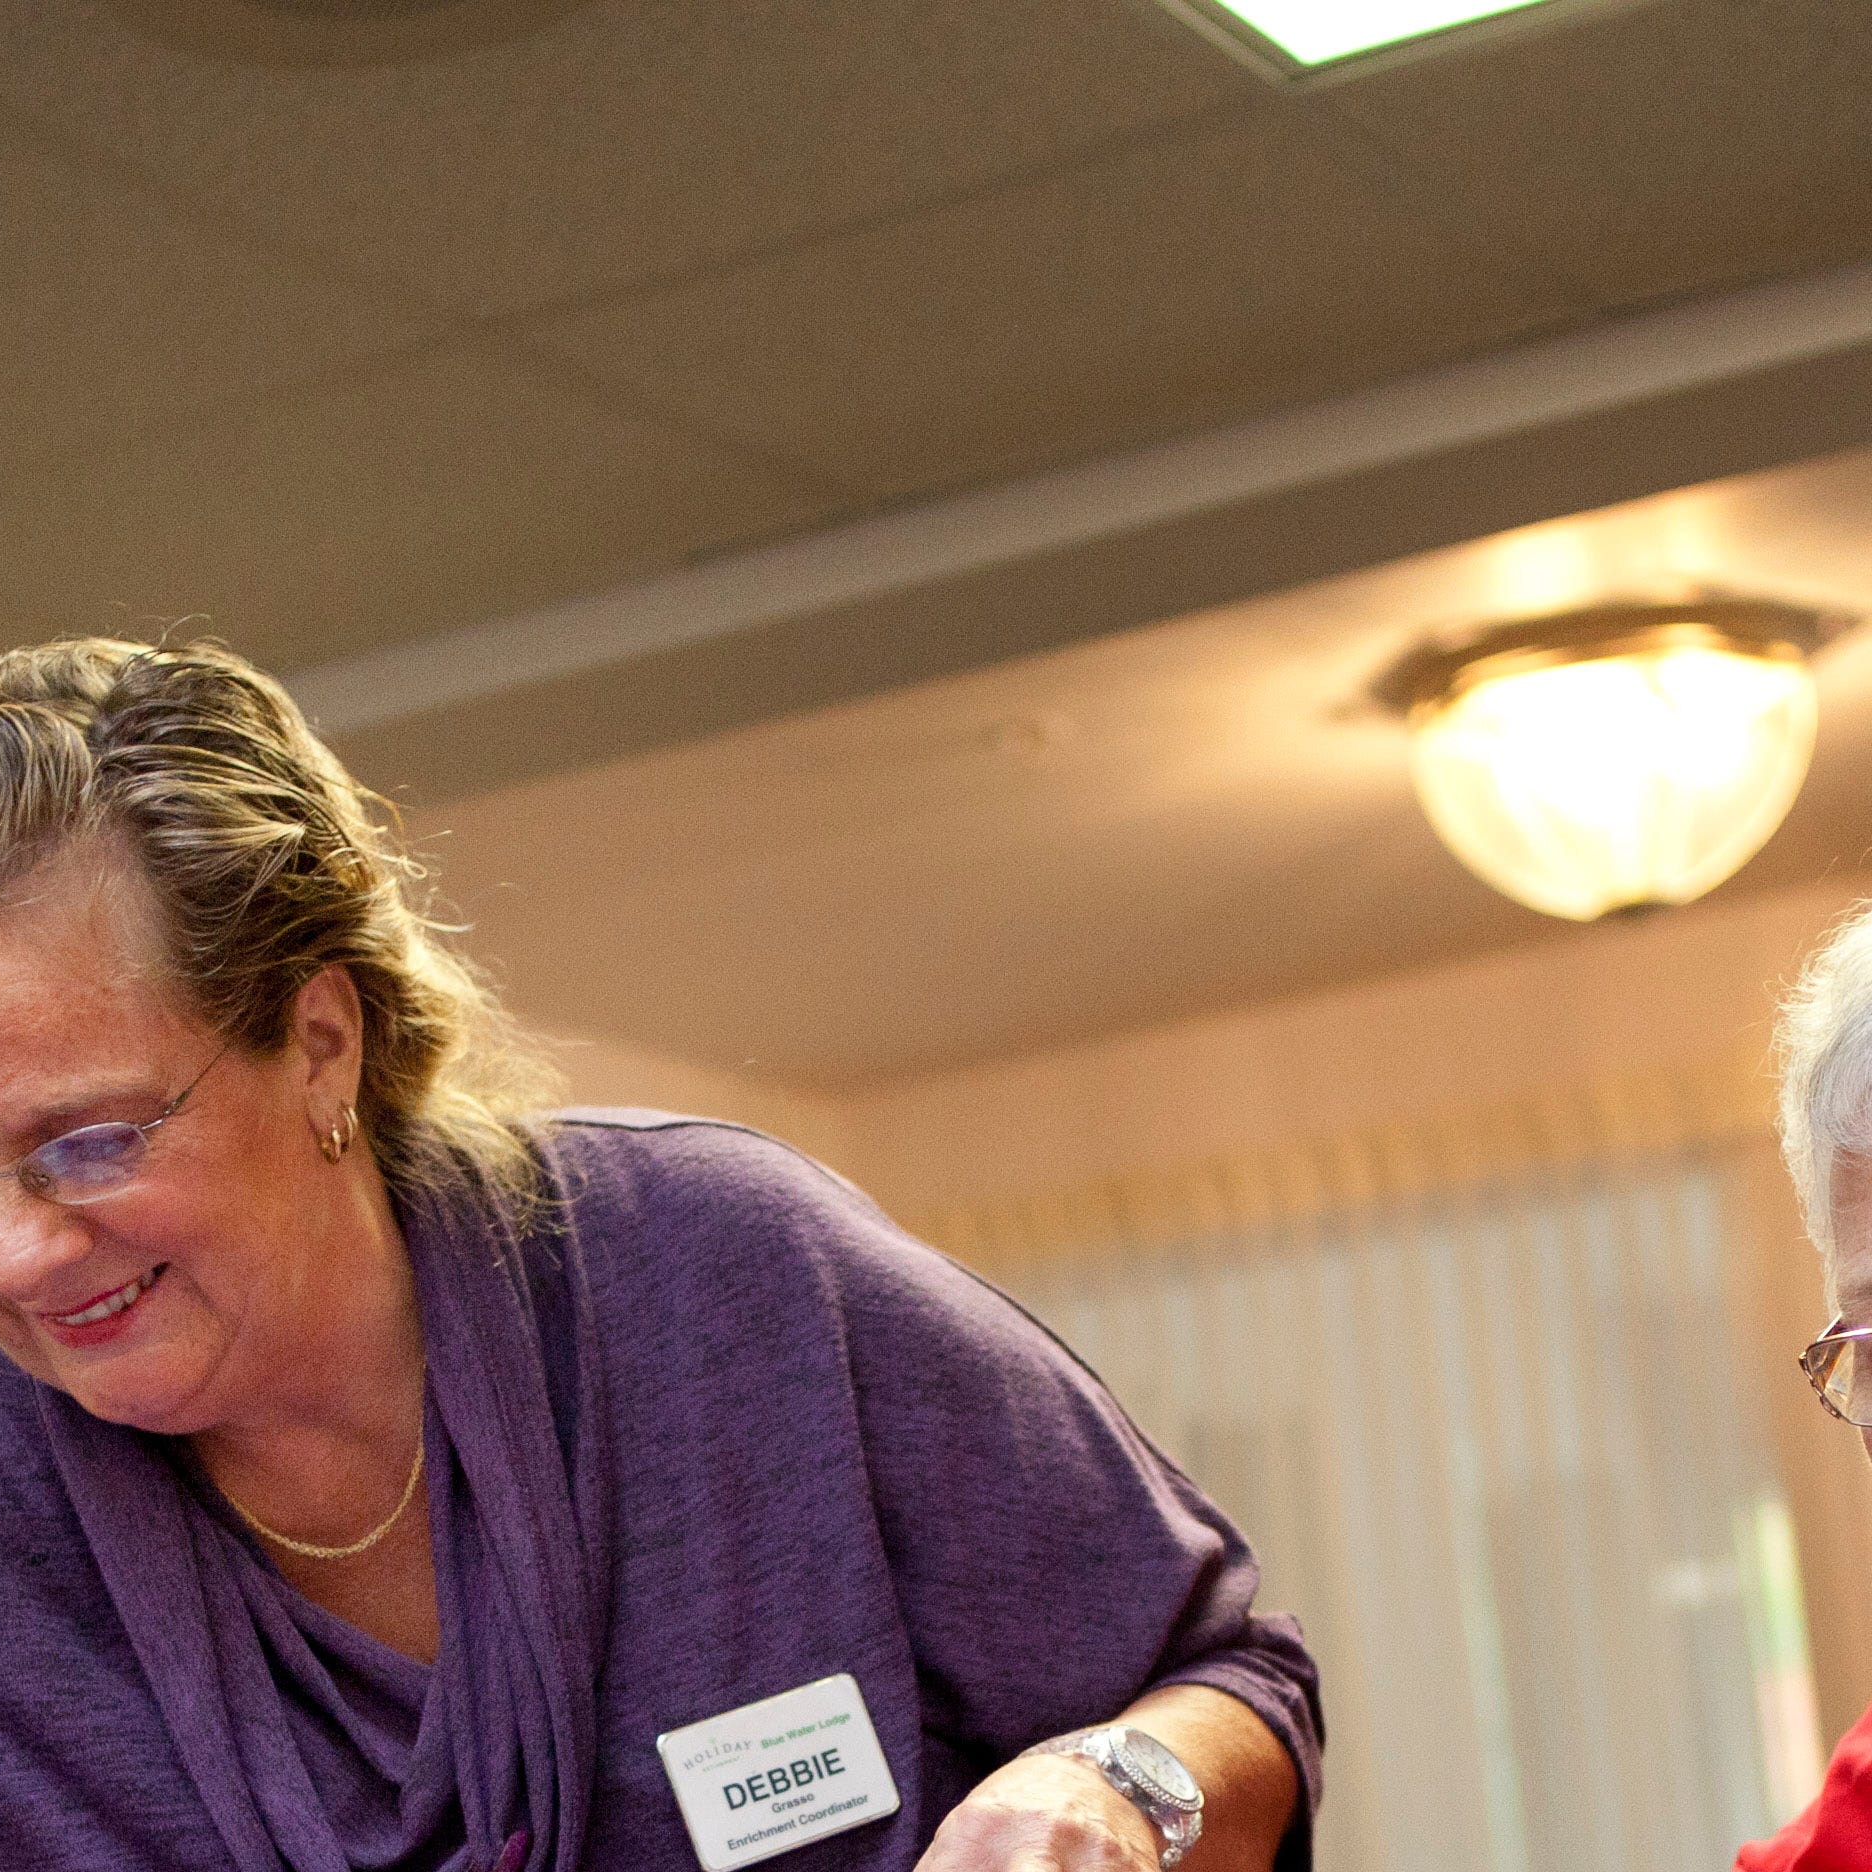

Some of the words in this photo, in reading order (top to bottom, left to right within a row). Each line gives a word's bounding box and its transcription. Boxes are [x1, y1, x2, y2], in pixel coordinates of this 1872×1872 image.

[760, 1735, 786, 1750] Blue
[786, 1724, 817, 1740] Water
[818, 1712, 851, 1730] Lodge
[683, 1738, 753, 1771] HOLIDAY
[722, 1748, 846, 1810] DEBBIE
[727, 1818, 797, 1850] Enrichment
[798, 1793, 869, 1826] Coordinator
[771, 1792, 815, 1814] Grasso
